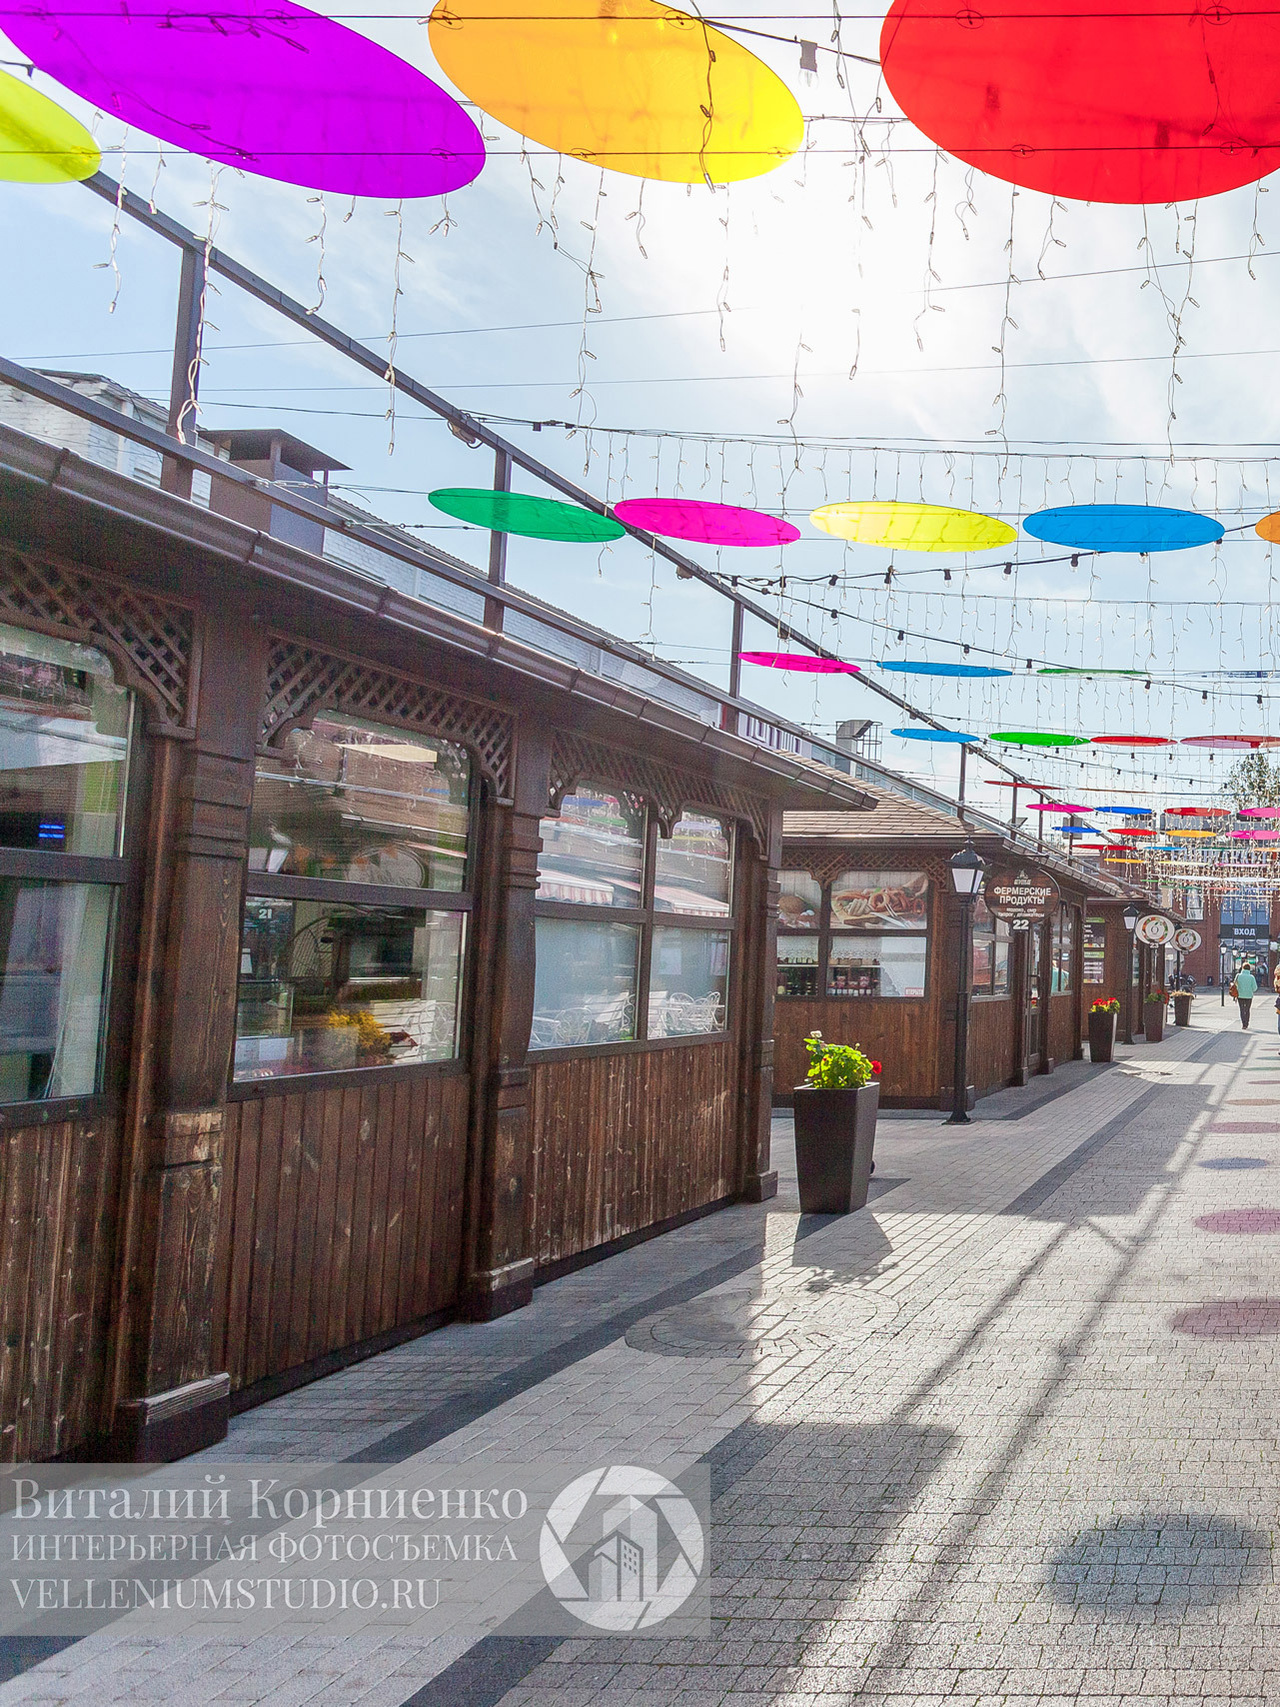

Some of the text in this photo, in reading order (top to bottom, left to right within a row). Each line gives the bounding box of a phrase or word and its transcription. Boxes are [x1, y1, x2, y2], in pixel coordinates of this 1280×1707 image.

[994, 886, 1052, 896] ФЕРМЕРСКИЕ
[999, 895, 1045, 905] ПРОДУКТЫ
[258, 908, 273, 919] 21
[1013, 919, 1029, 930] 22
[1234, 927, 1256, 936] ВХОД
